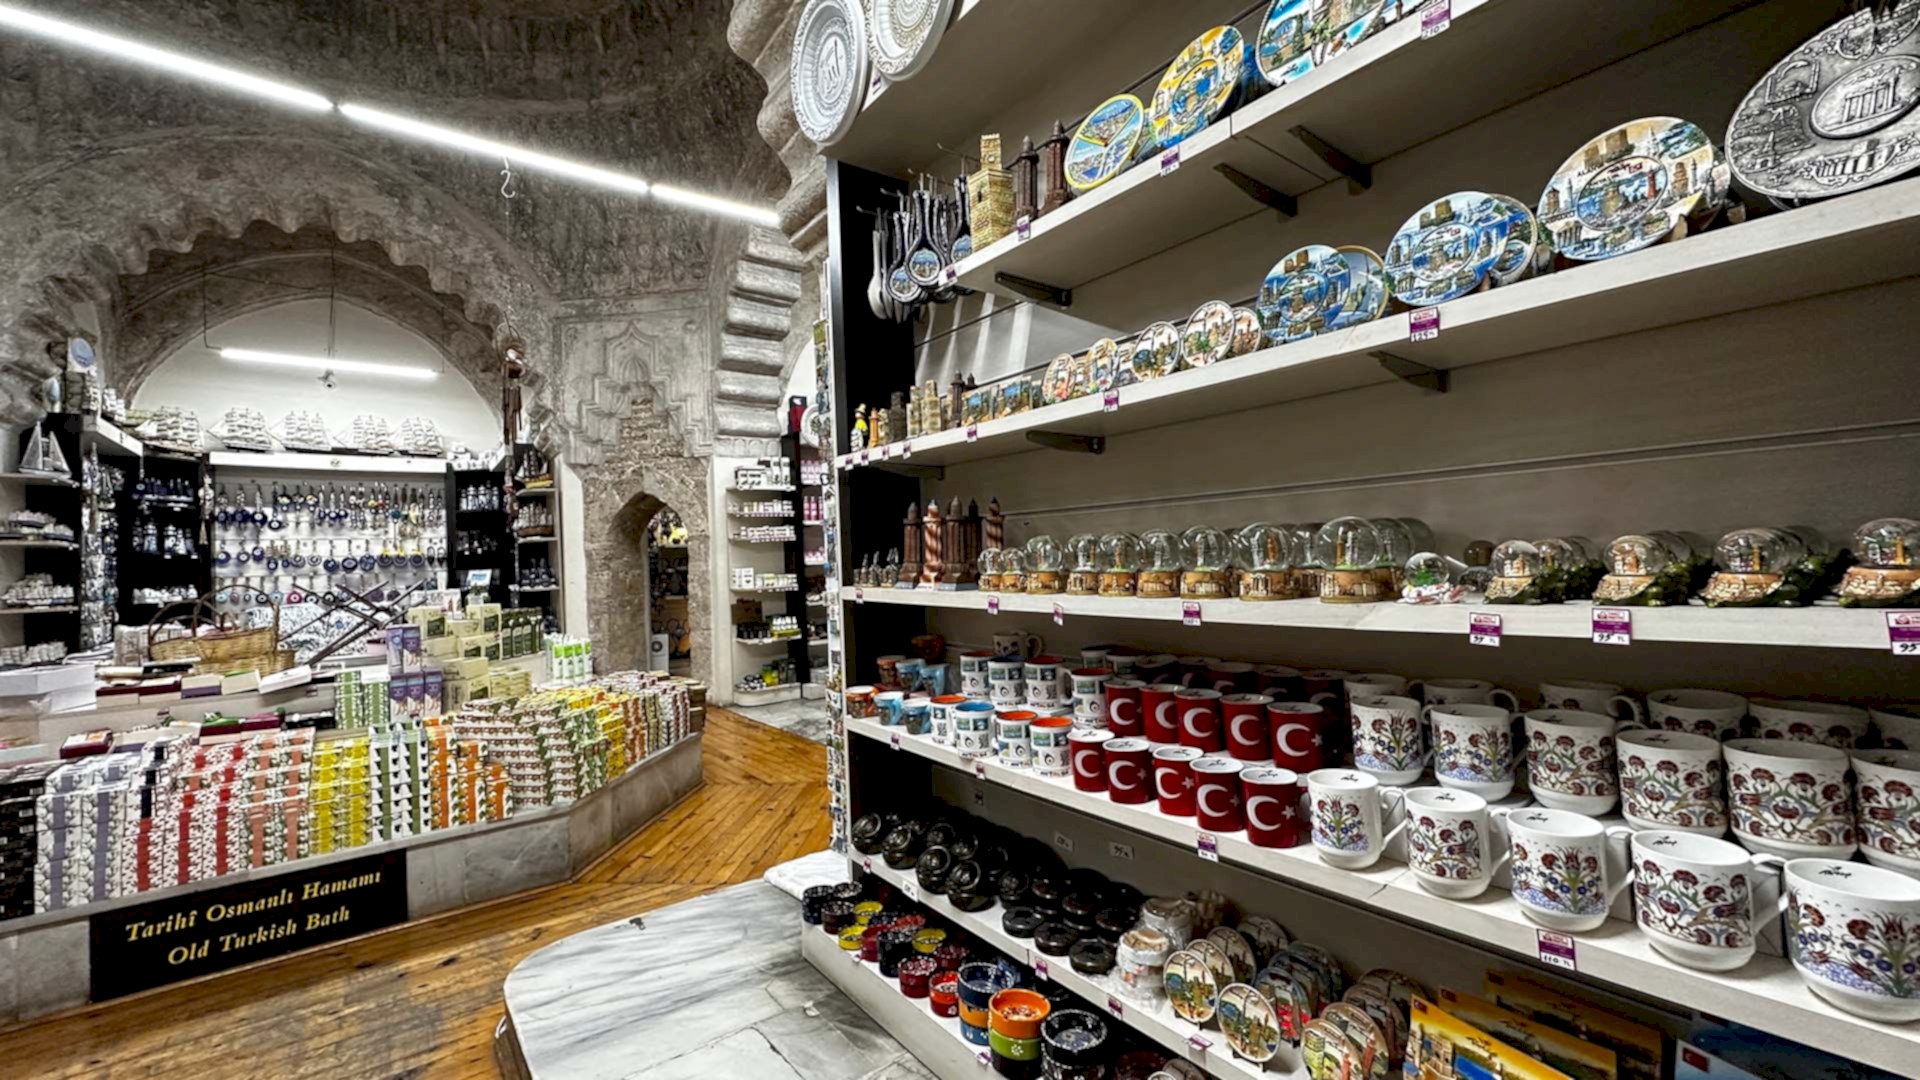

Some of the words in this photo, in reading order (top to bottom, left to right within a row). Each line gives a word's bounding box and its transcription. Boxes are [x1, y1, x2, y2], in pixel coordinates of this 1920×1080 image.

[126, 910, 198, 942] Tarihî
[206, 888, 293, 922] Osmanlı
[302, 871, 381, 900] Hamamı
[168, 939, 210, 965] Old
[219, 919, 298, 952] Turkish
[305, 905, 350, 931] Bath
